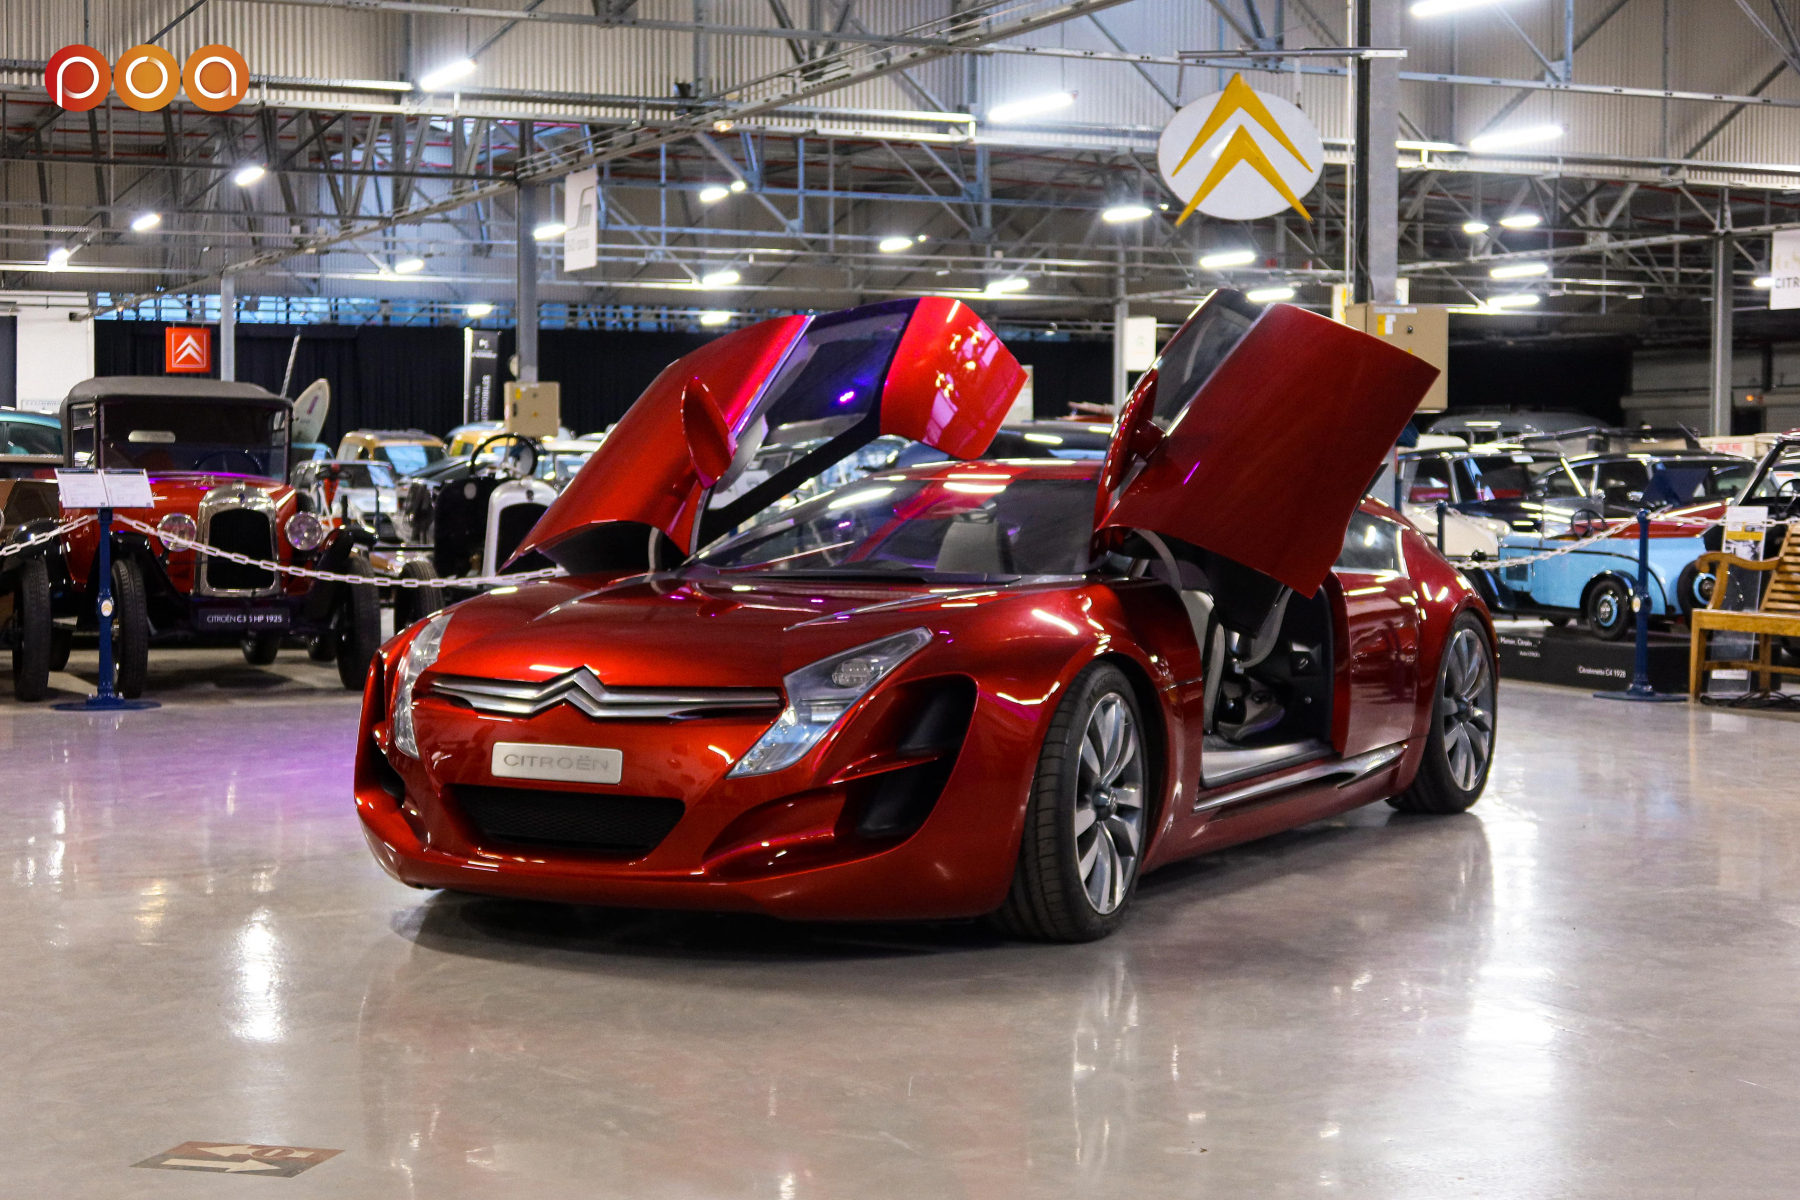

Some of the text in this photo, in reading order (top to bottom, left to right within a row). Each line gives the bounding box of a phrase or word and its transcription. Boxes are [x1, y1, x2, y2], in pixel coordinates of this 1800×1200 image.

[207, 614, 236, 623] CITROËN
[266, 614, 282, 623] 1925
[503, 753, 609, 772] CITROËN
